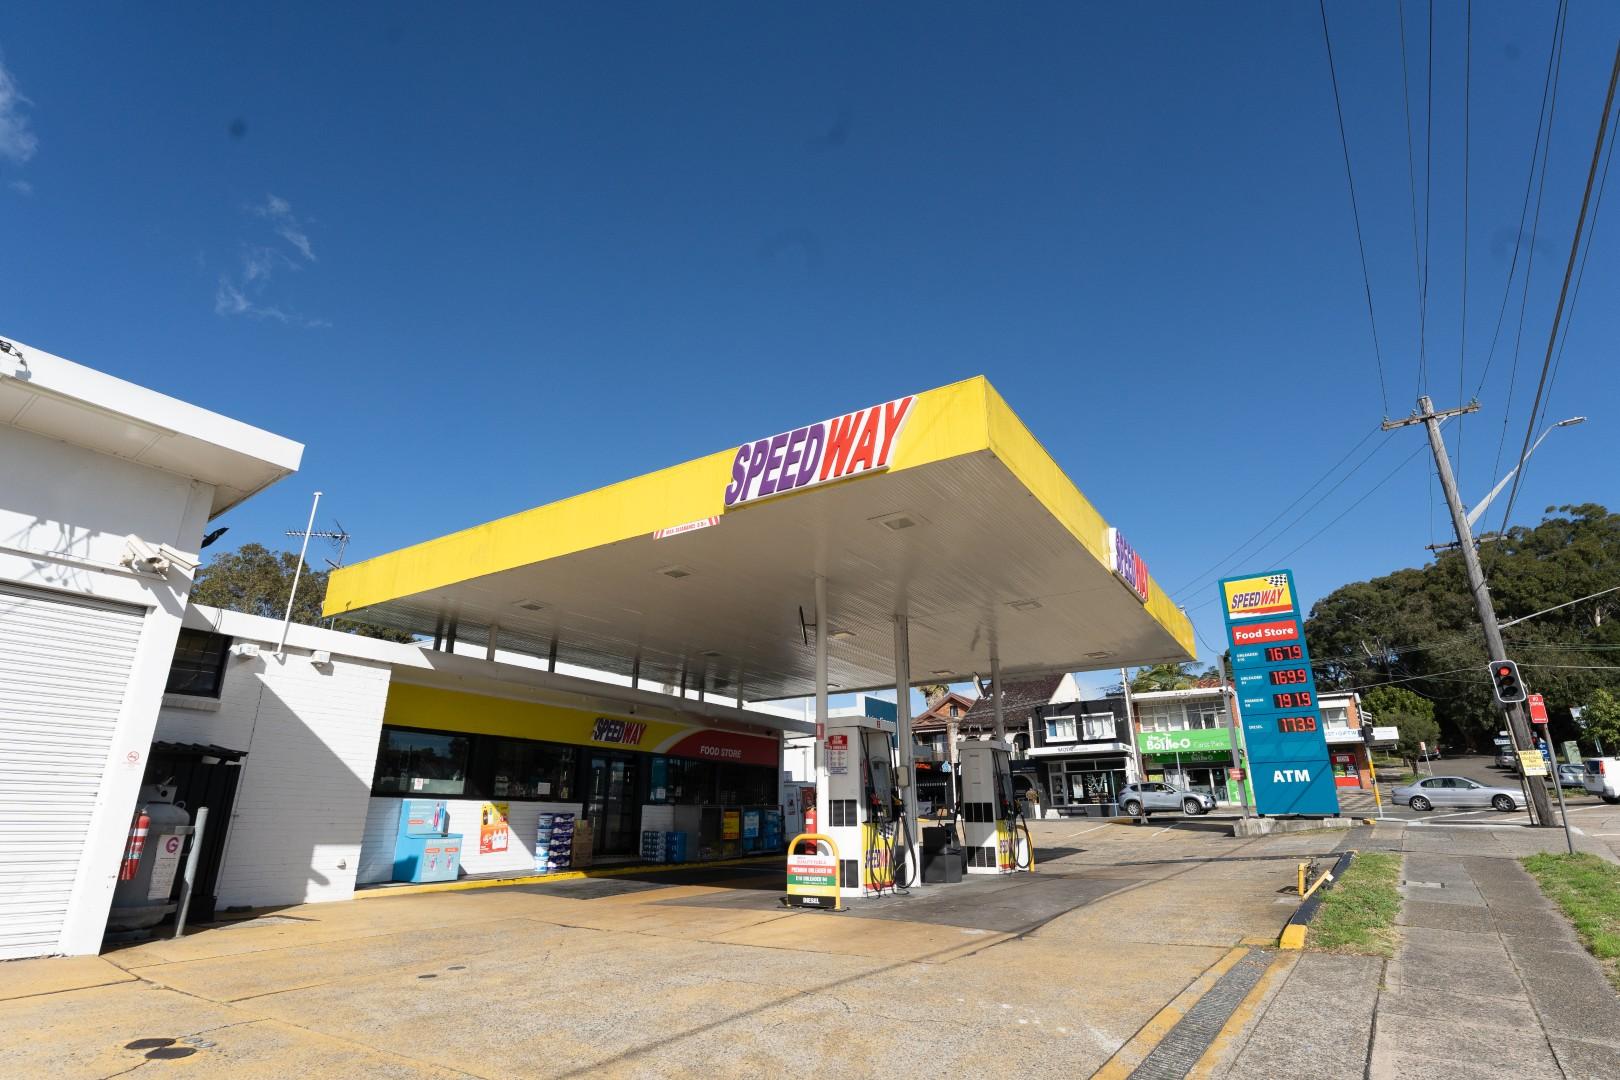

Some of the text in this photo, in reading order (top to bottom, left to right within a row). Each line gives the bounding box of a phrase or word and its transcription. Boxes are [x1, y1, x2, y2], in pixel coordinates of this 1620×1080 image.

[724, 396, 913, 506] SPEEDWAY
[1115, 528, 1149, 601] SPEEDWAY
[1231, 587, 1285, 609] SPEEDWAY
[1235, 627, 1294, 640] Food Store
[592, 717, 647, 745] SPEEDWAY
[700, 745, 742, 759] FOOD STORE
[1272, 769, 1310, 783] ATM
